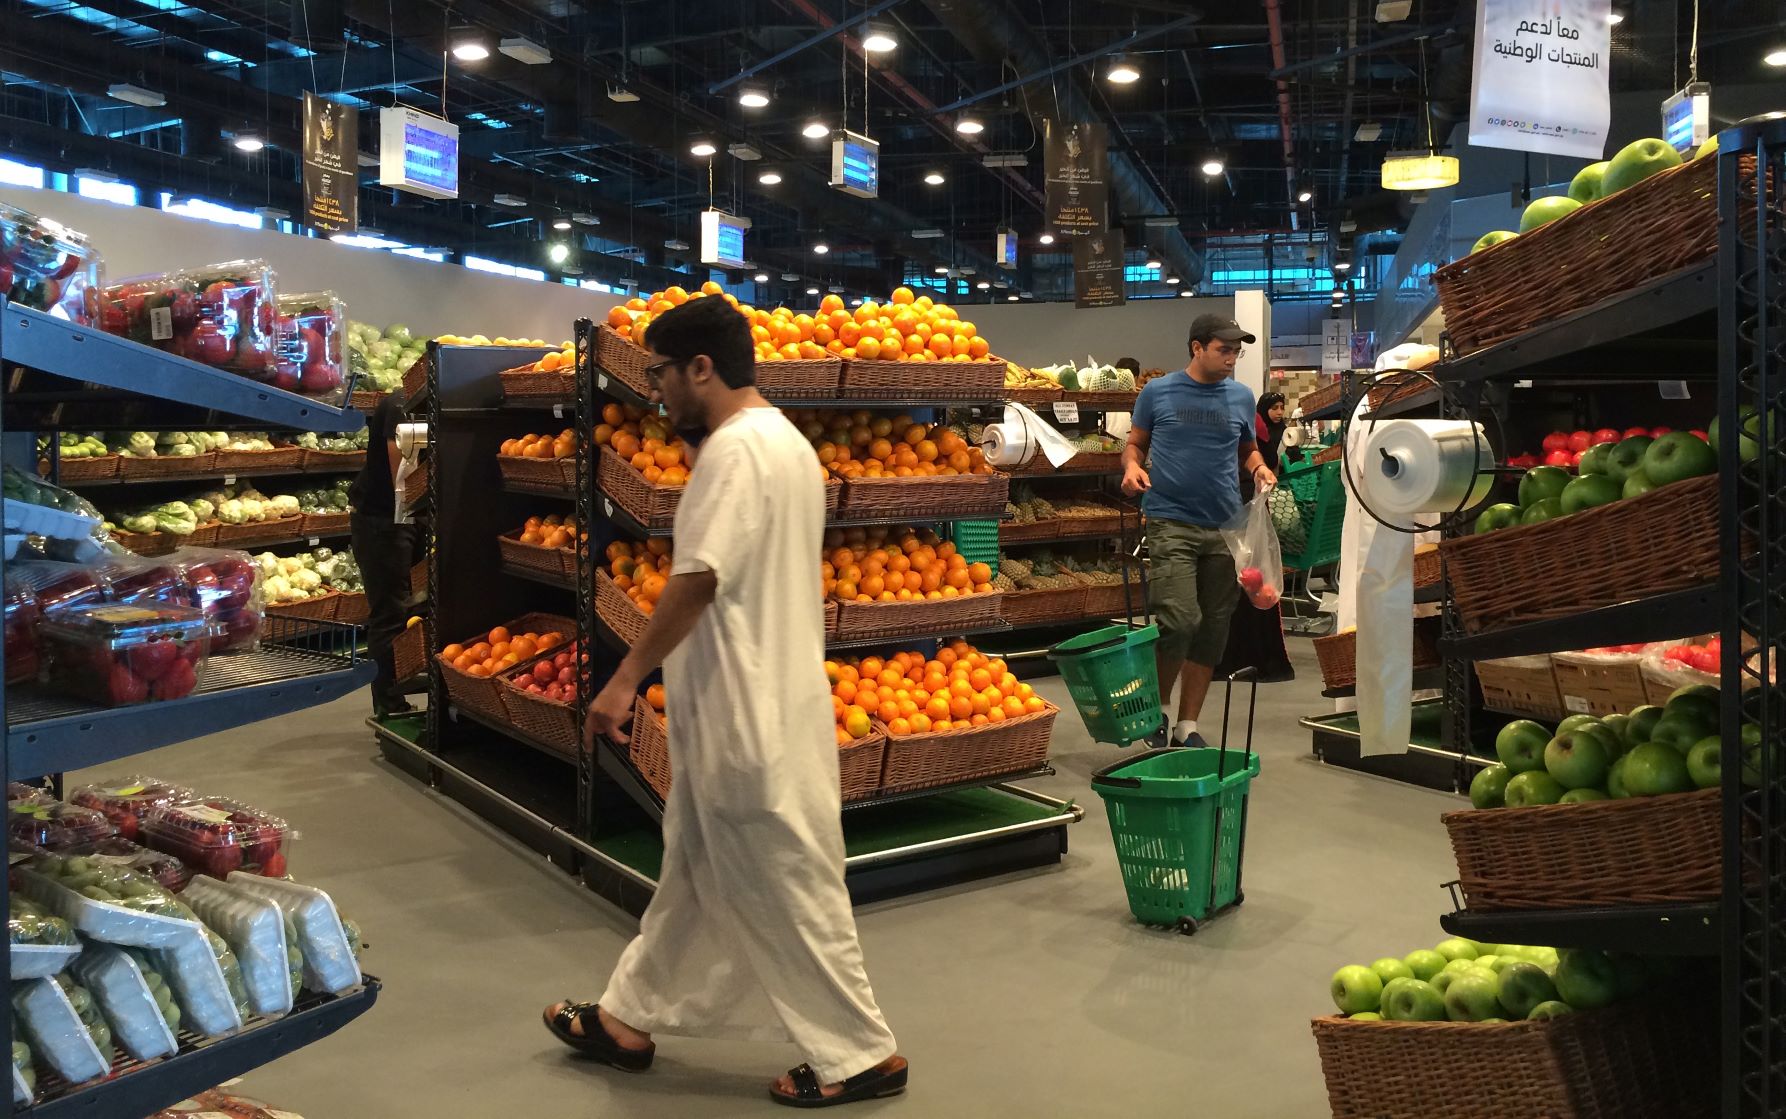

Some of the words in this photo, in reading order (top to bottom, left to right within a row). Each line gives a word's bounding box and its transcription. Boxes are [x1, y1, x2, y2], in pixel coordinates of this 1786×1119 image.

[1516, 19, 1552, 36] لدعم
[1556, 16, 1579, 40] معاً
[1494, 39, 1543, 63] الوطنية
[1548, 47, 1599, 69] المنتجات
